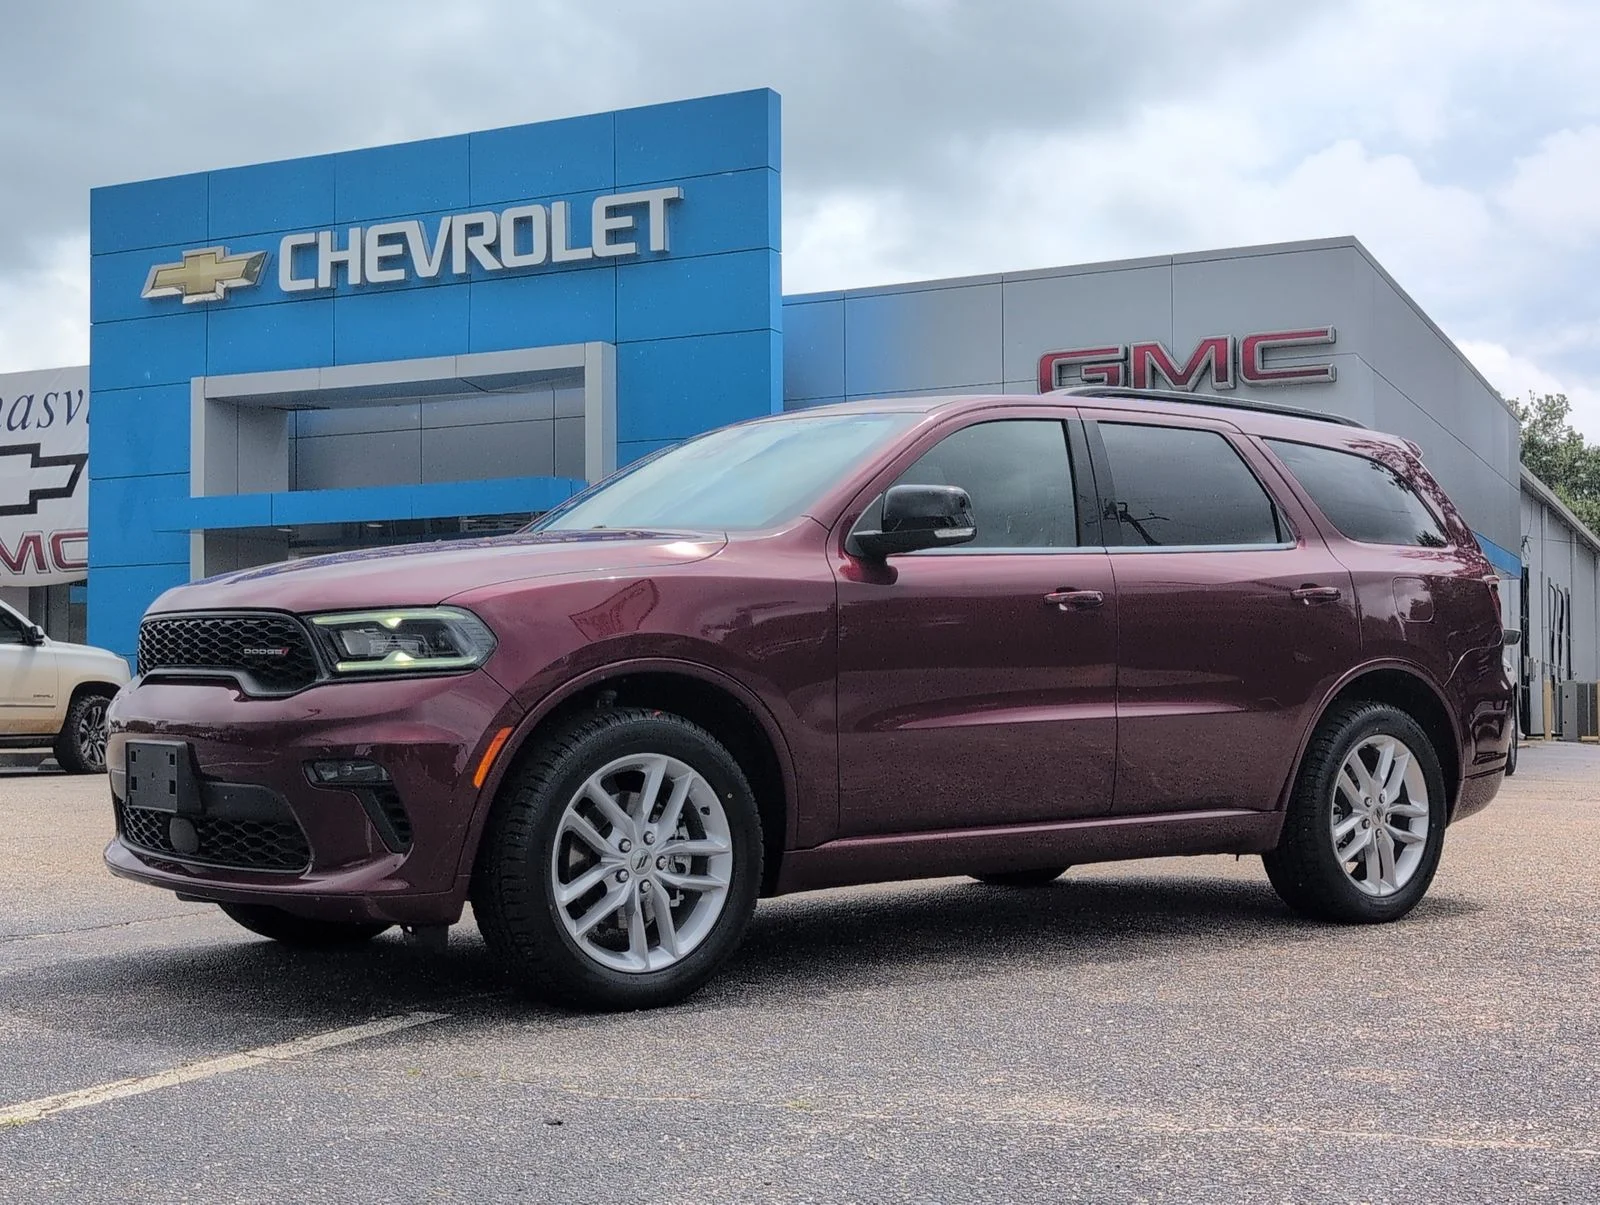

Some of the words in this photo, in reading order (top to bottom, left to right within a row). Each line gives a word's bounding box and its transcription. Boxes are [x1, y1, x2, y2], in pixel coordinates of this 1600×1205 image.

[278, 186, 683, 293] CHEVROLET
[1037, 325, 1336, 394] GMC
[0, 389, 89, 431] asv
